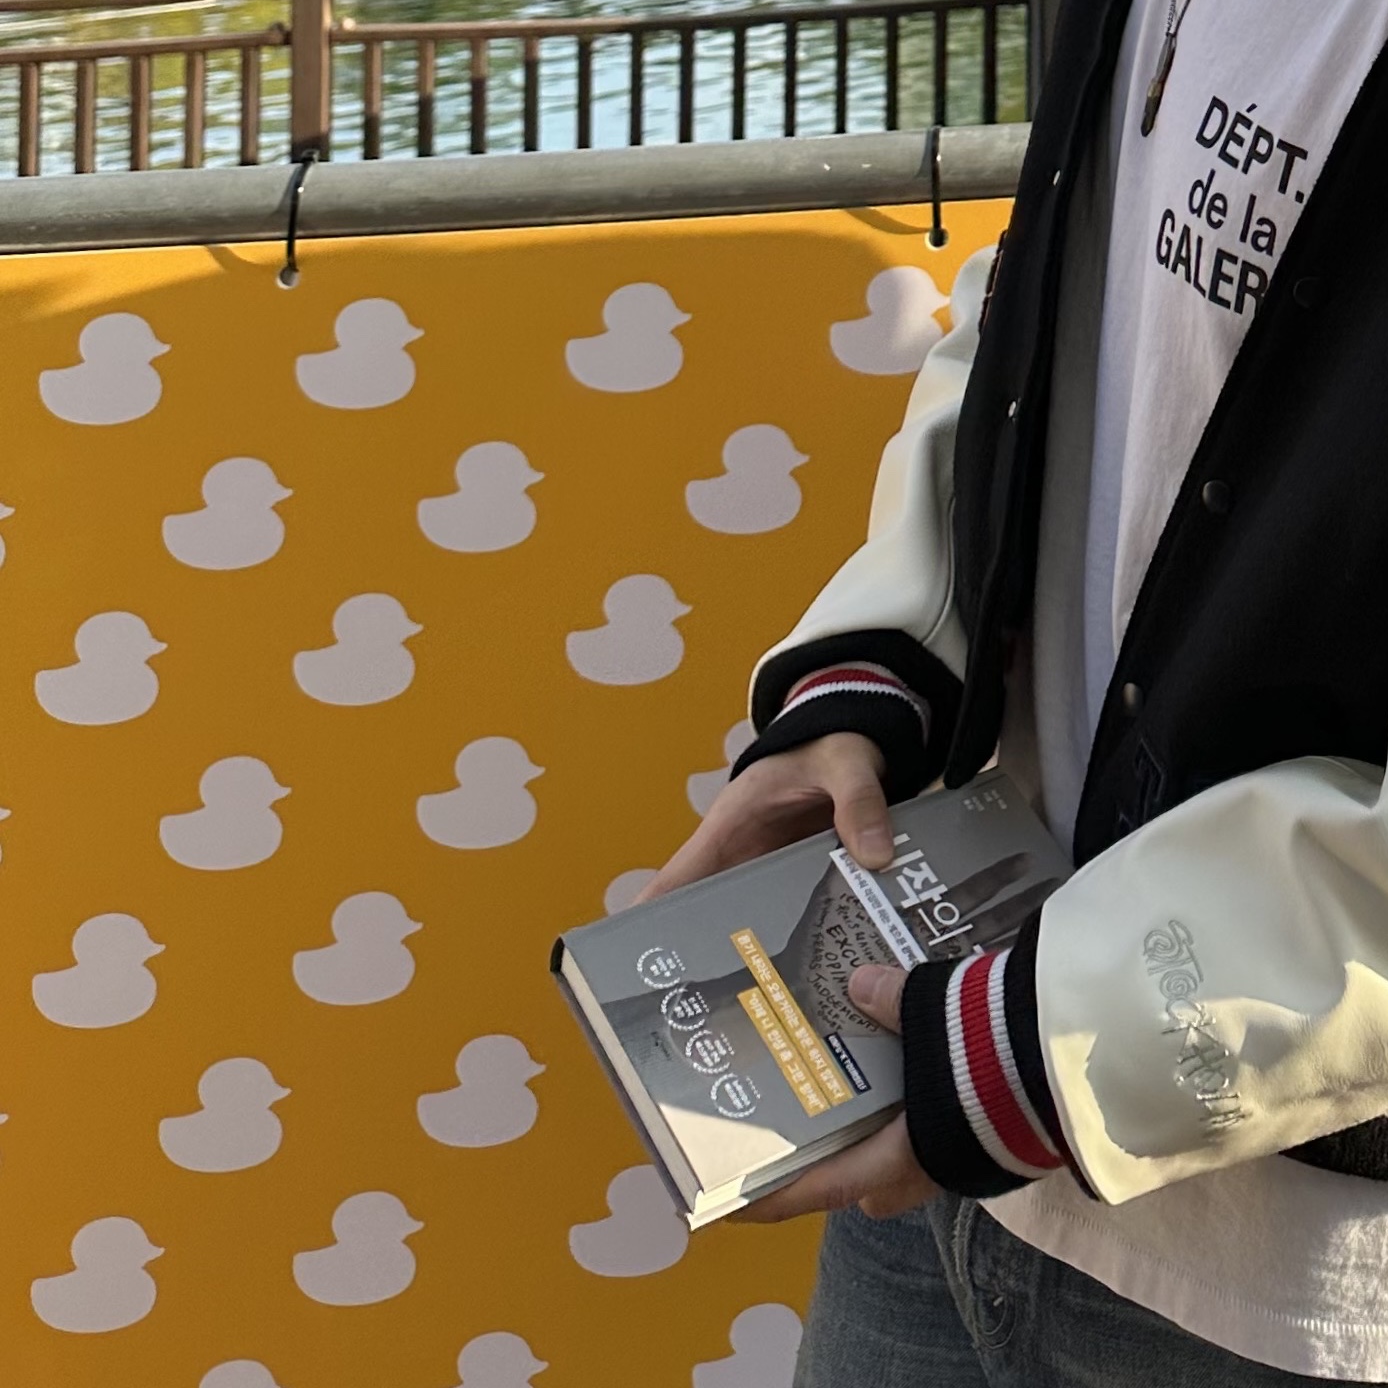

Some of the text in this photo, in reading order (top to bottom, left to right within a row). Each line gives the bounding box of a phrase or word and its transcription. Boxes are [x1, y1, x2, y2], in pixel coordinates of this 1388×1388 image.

[1195, 95, 1308, 204] DÉPT.
[1188, 169, 1276, 256] de la
